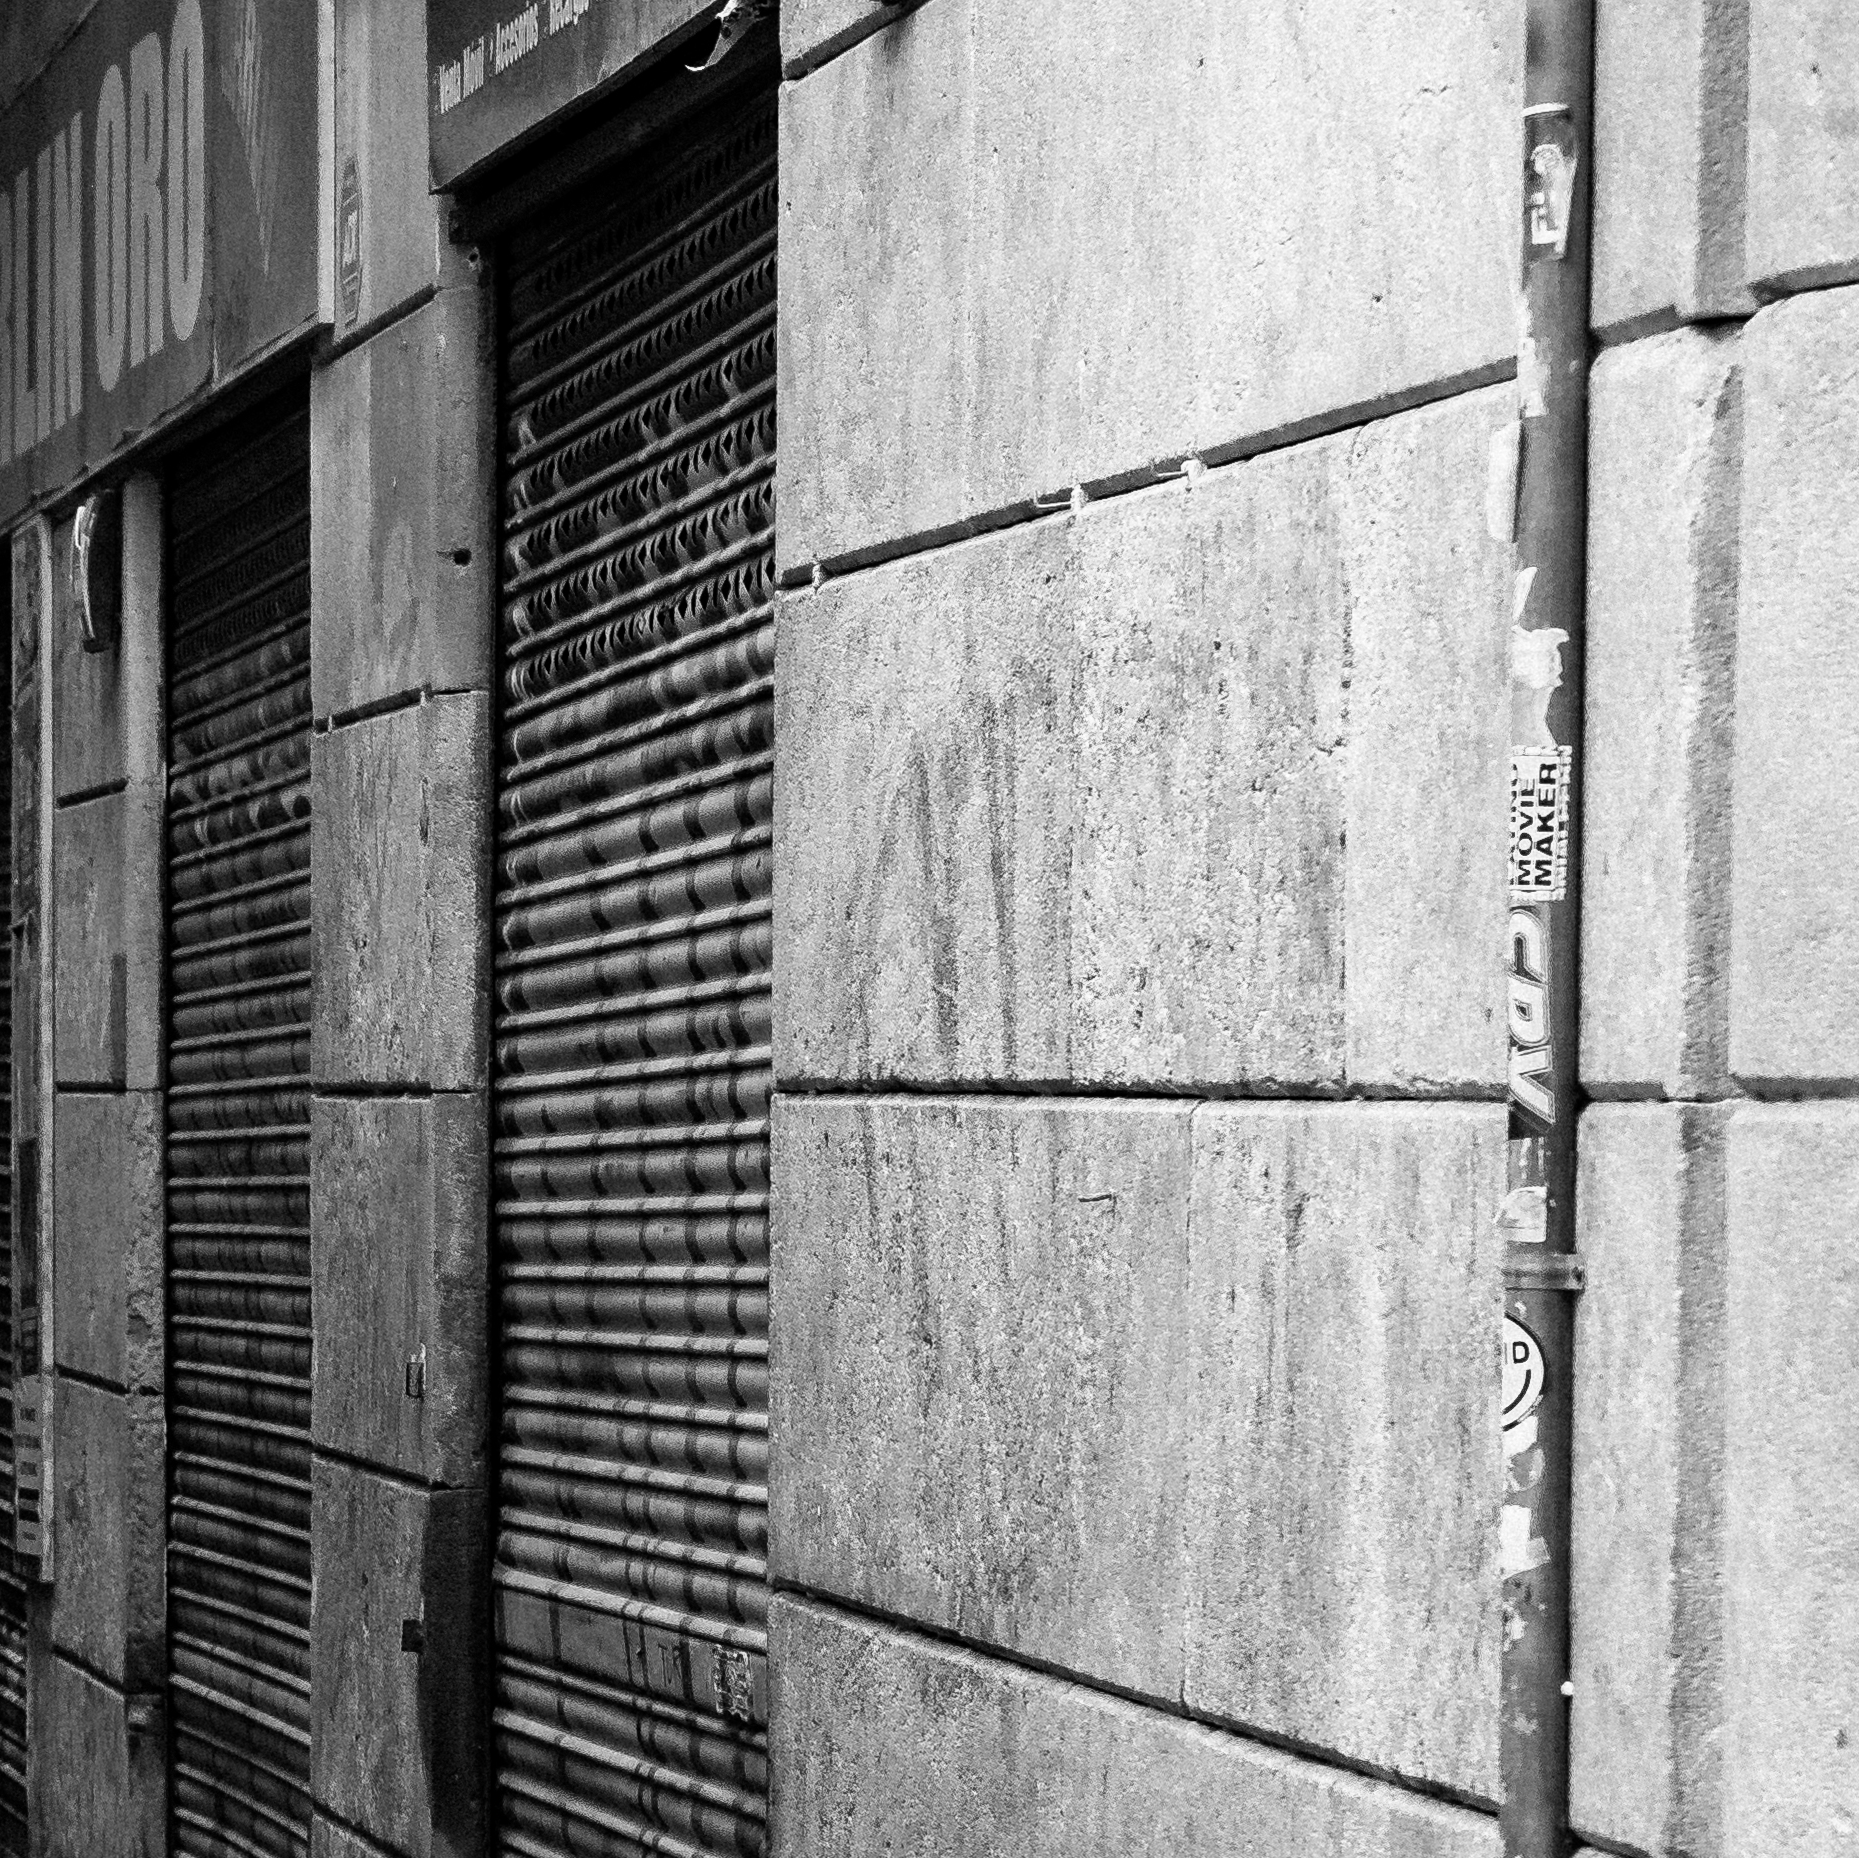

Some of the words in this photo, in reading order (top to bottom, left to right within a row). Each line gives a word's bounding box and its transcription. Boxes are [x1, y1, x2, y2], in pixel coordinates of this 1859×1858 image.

[94, 0, 205, 392] ORO
[1516, 777, 1536, 886] MOVIE
[1534, 762, 1558, 887] MAKER
